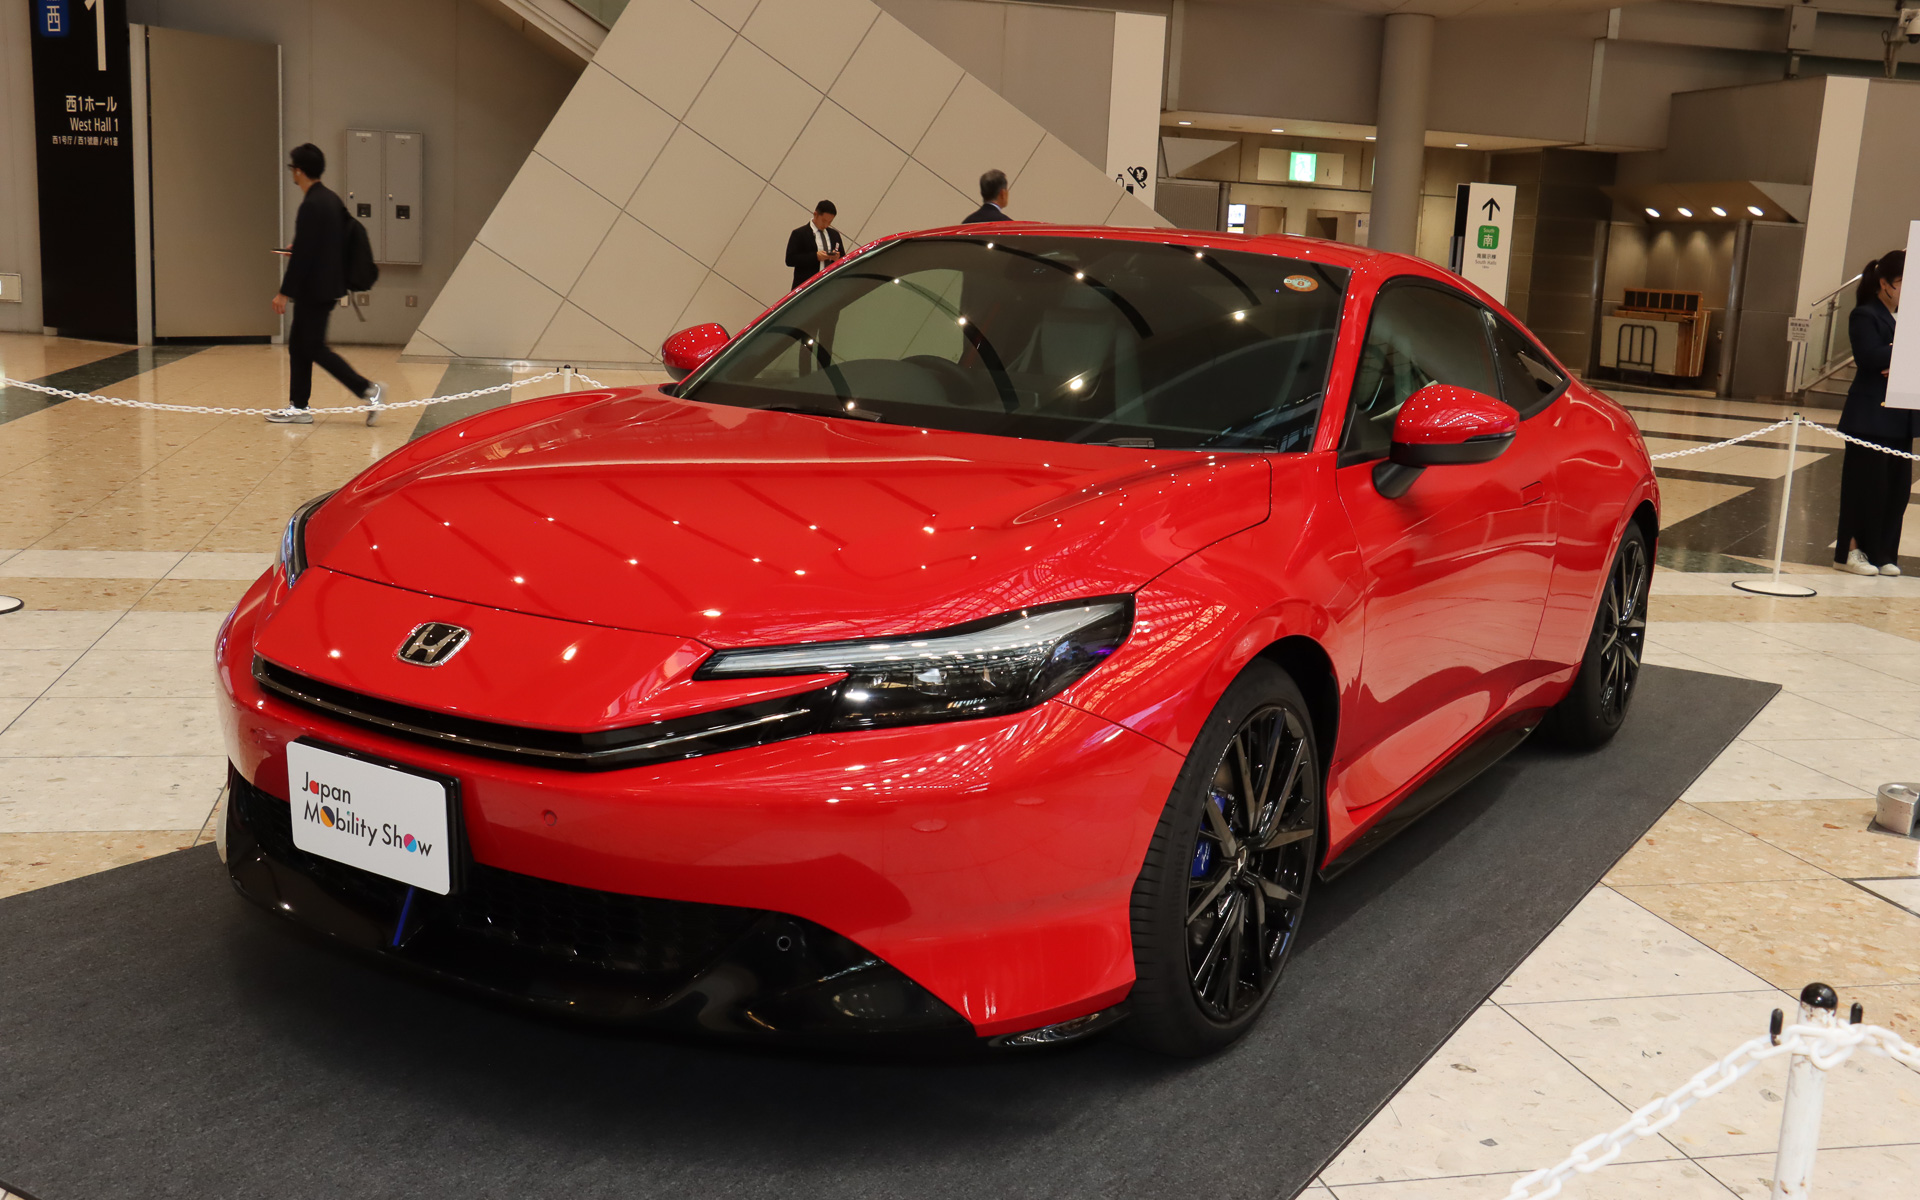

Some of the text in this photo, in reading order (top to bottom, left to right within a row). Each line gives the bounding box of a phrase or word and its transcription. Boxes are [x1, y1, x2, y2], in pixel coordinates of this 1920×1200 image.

[46, 5, 61, 32] 西
[84, 0, 107, 71] 1
[65, 95, 117, 112] 西1ホール
[69, 117, 119, 132] West Hall 1
[1483, 234, 1493, 247] 南
[302, 771, 351, 804] Japan
